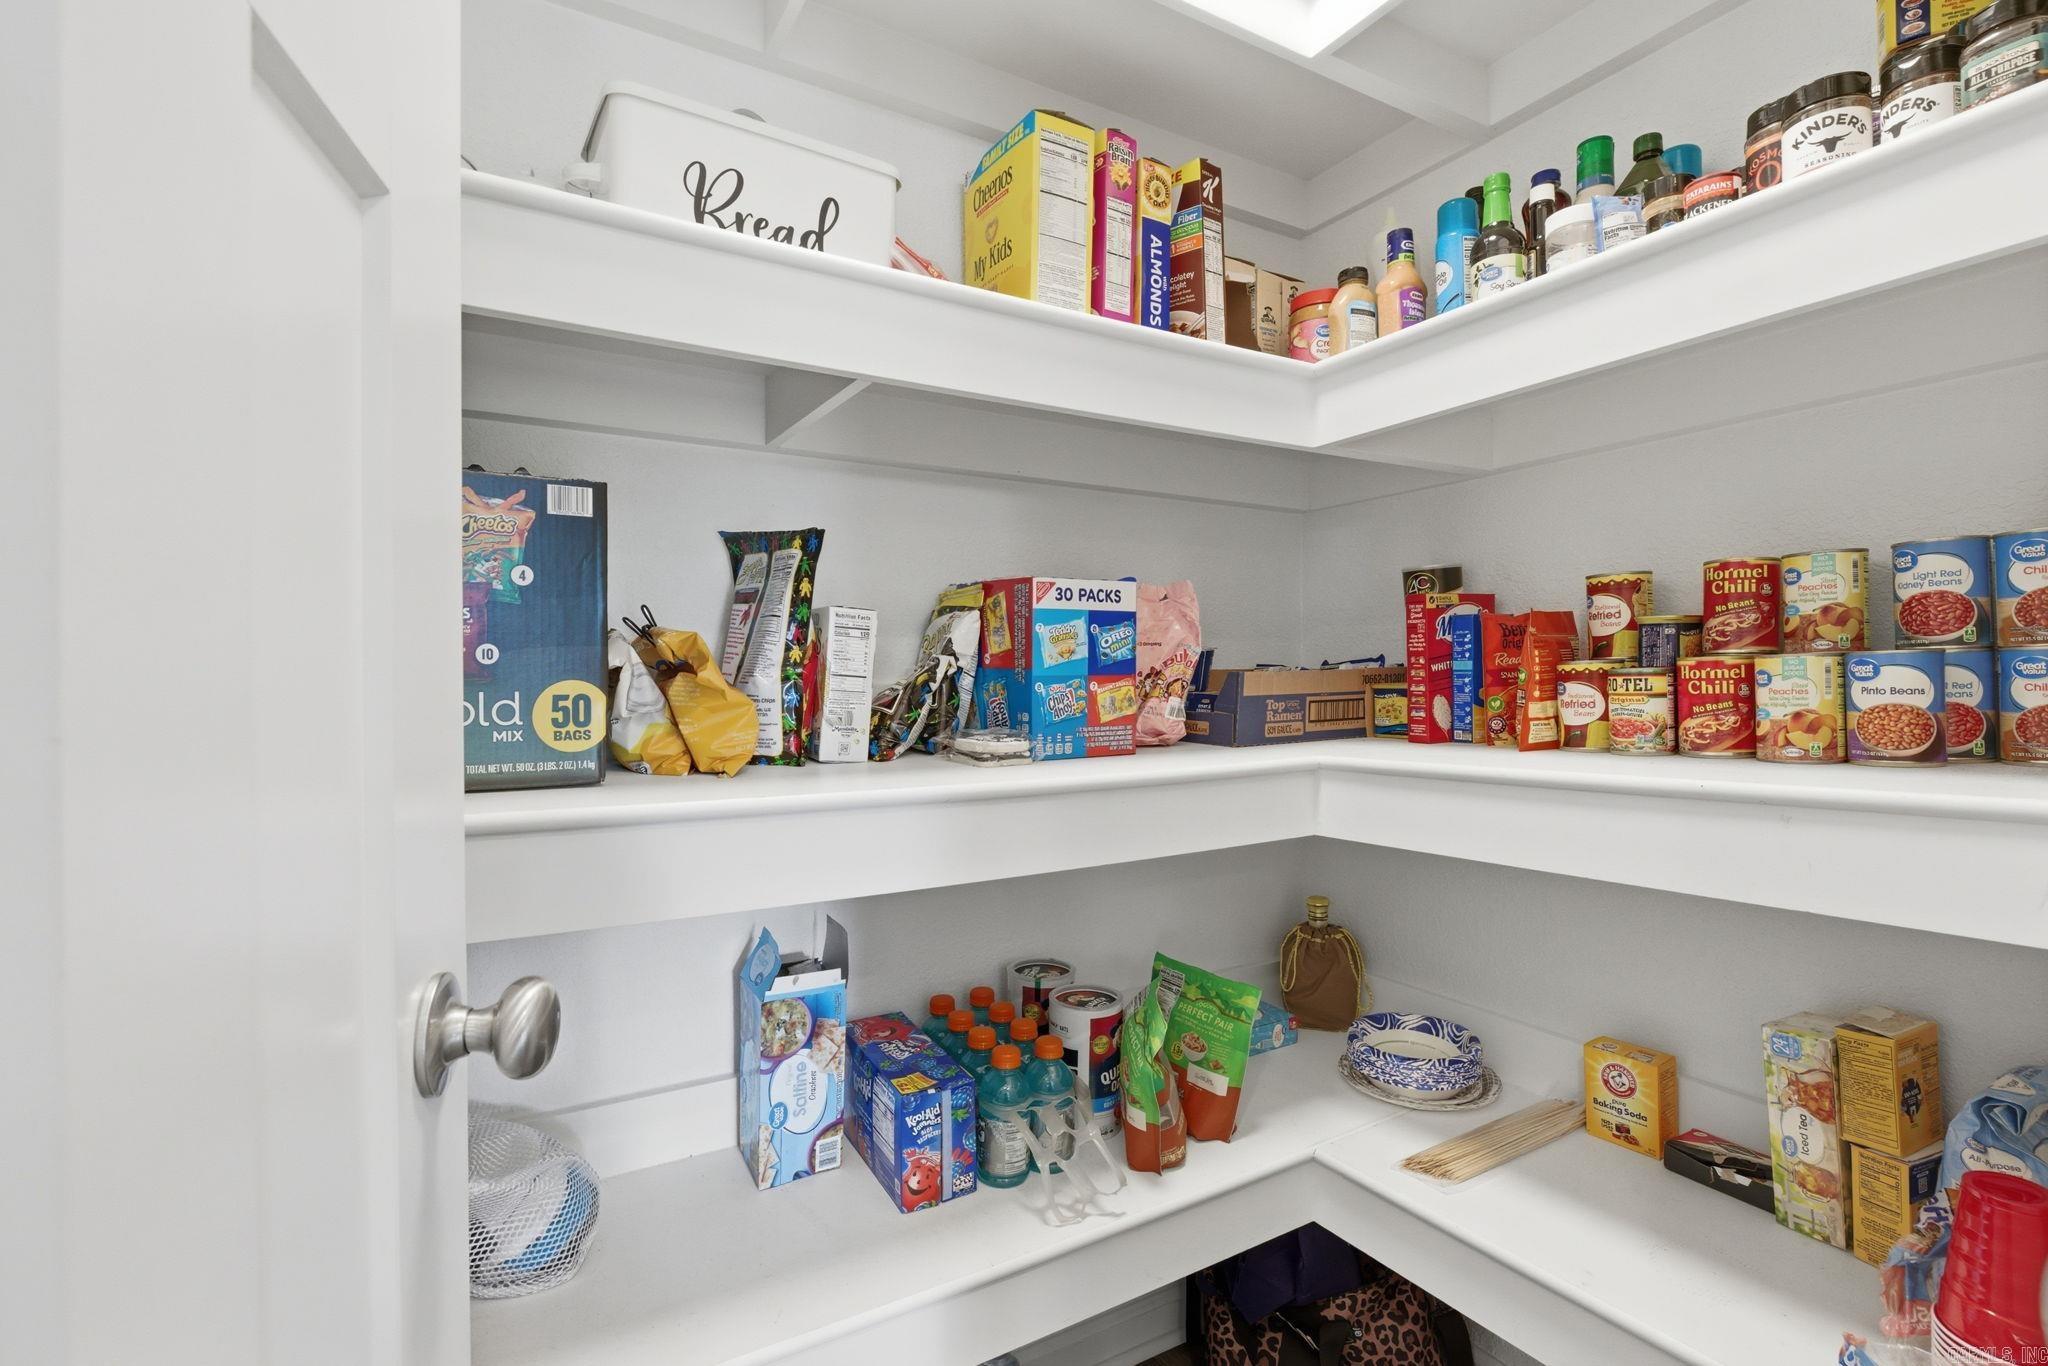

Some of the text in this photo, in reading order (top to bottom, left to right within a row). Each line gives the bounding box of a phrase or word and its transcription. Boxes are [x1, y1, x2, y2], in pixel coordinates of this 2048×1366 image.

[1991, 51, 2037, 78] PURPOSE
[1108, 142, 1134, 159] Raisin
[1112, 152, 1132, 166] Bran
[973, 166, 1013, 213] Cheerios
[1202, 176, 1220, 204] K
[1177, 212, 1198, 225] Fiber
[989, 237, 1013, 269] Kids
[1149, 234, 1163, 327] ALMONDS
[1170, 271, 1195, 284] colatey
[2014, 543, 2046, 555] Great
[2020, 551, 2046, 559] Value
[519, 569, 526, 581] 4
[1706, 564, 1768, 581] Hormel
[1912, 568, 1962, 581] Light Red
[2023, 565, 2048, 576] Chil
[1711, 579, 1757, 595] Chili
[1797, 582, 1838, 592] Peaches
[1928, 578, 1963, 587] Beans
[1055, 587, 1122, 604] 30 PACKS
[1588, 609, 1622, 621] Refried
[1715, 604, 1727, 613] No
[1049, 624, 1077, 636] Teddy
[1100, 627, 1134, 649] OREO
[481, 648, 494, 660] 10
[1681, 664, 1746, 680] Hormel
[1850, 663, 1875, 673] Great
[2015, 662, 2047, 671] Great
[1687, 680, 1735, 695] Chili
[1768, 687, 1809, 695] Peaches
[1861, 686, 1926, 696] Pinto Beans
[1951, 682, 1973, 690] Red
[2024, 682, 2048, 693] Chil
[1945, 690, 1974, 698] eans
[1047, 690, 1070, 712] Chips
[1265, 699, 1286, 712] Top
[1560, 699, 1596, 709] Refried
[1692, 700, 1734, 713] No Beans
[551, 693, 592, 729] 50
[1265, 710, 1304, 722] Ramen
[492, 730, 524, 742] MIX
[553, 729, 592, 742] BAGS
[466, 764, 487, 774] TOTAL
[488, 764, 500, 774] NET
[501, 763, 515, 773] WT.
[578, 760, 587, 769] 1.4
[1179, 1002, 1234, 1032] PERFECT PAIR
[1772, 1036, 1790, 1055] 24
[793, 1061, 808, 1118] Saltine
[905, 1103, 941, 1129] Kool-Aid
[1593, 1097, 1623, 1116] Baking
[1624, 1108, 1648, 1122] Soda
[1799, 1113, 1810, 1156] Iced Tea
[1969, 1154, 2022, 1173] All-Purpose
